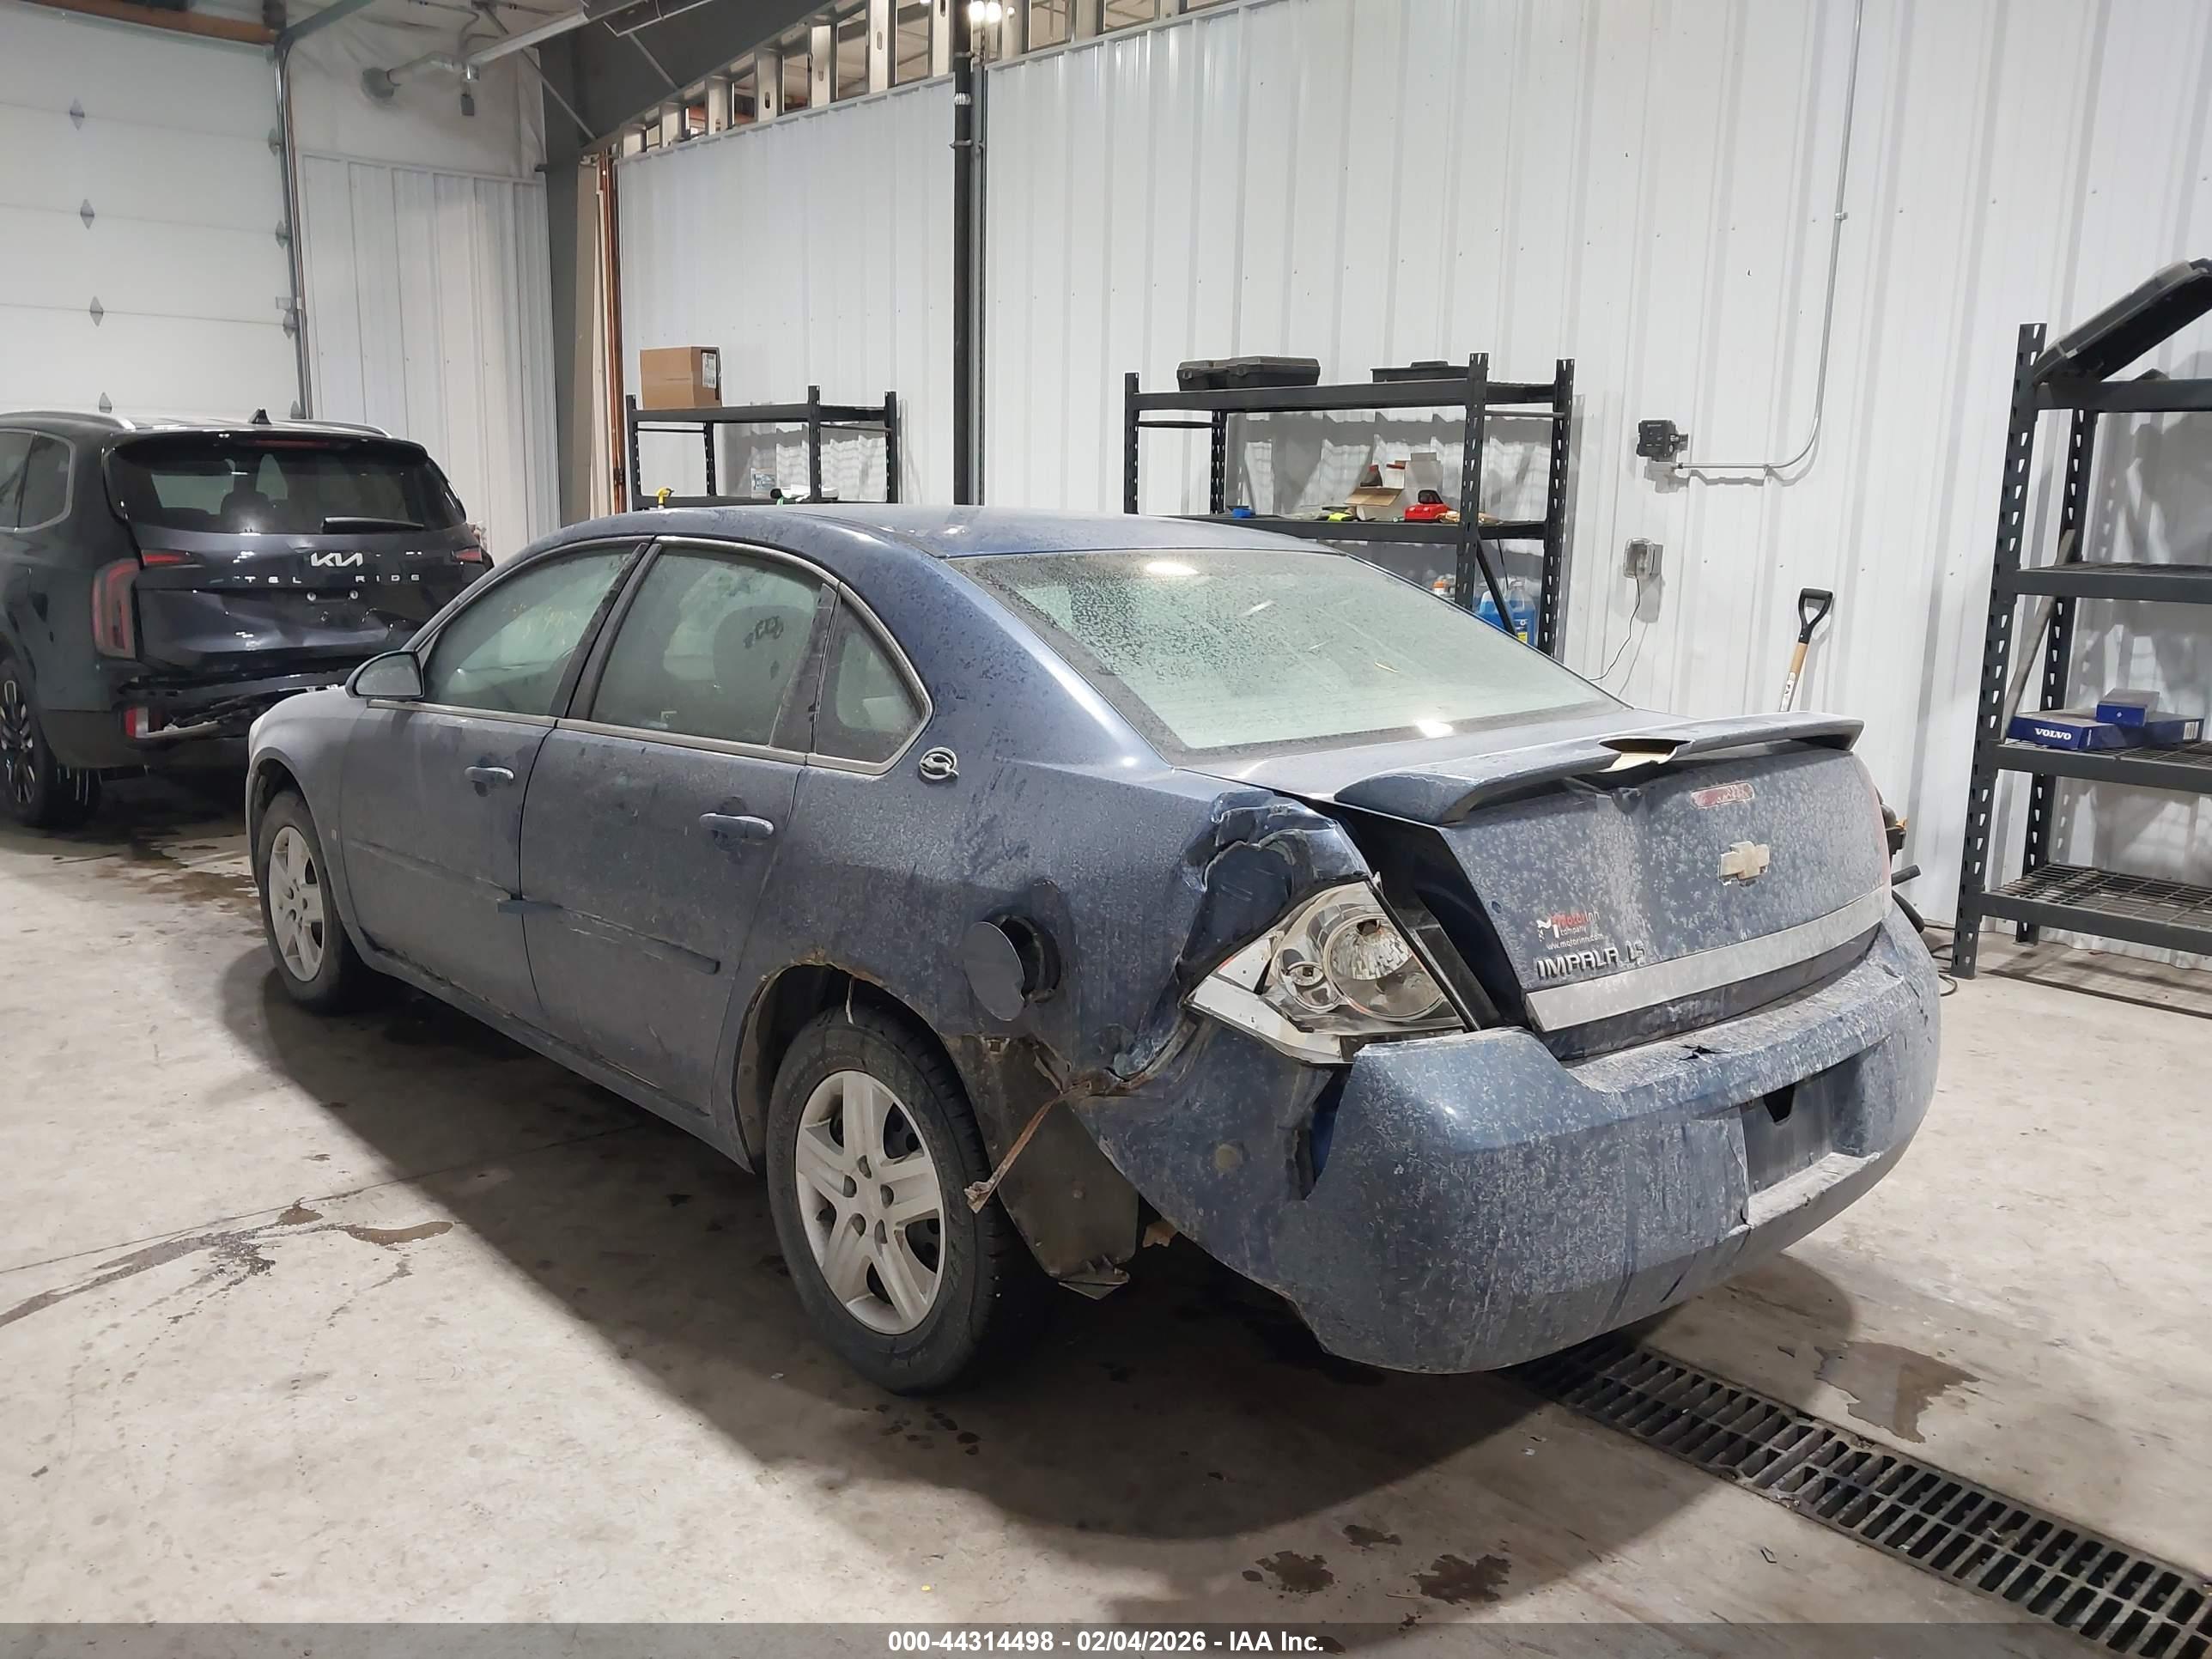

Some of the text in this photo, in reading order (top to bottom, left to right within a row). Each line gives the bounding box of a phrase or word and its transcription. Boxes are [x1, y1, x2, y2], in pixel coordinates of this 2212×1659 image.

[310, 552, 363, 568] KIA
[2034, 727, 2072, 740] VOLVO
[1536, 946, 1620, 978] IMPALA
